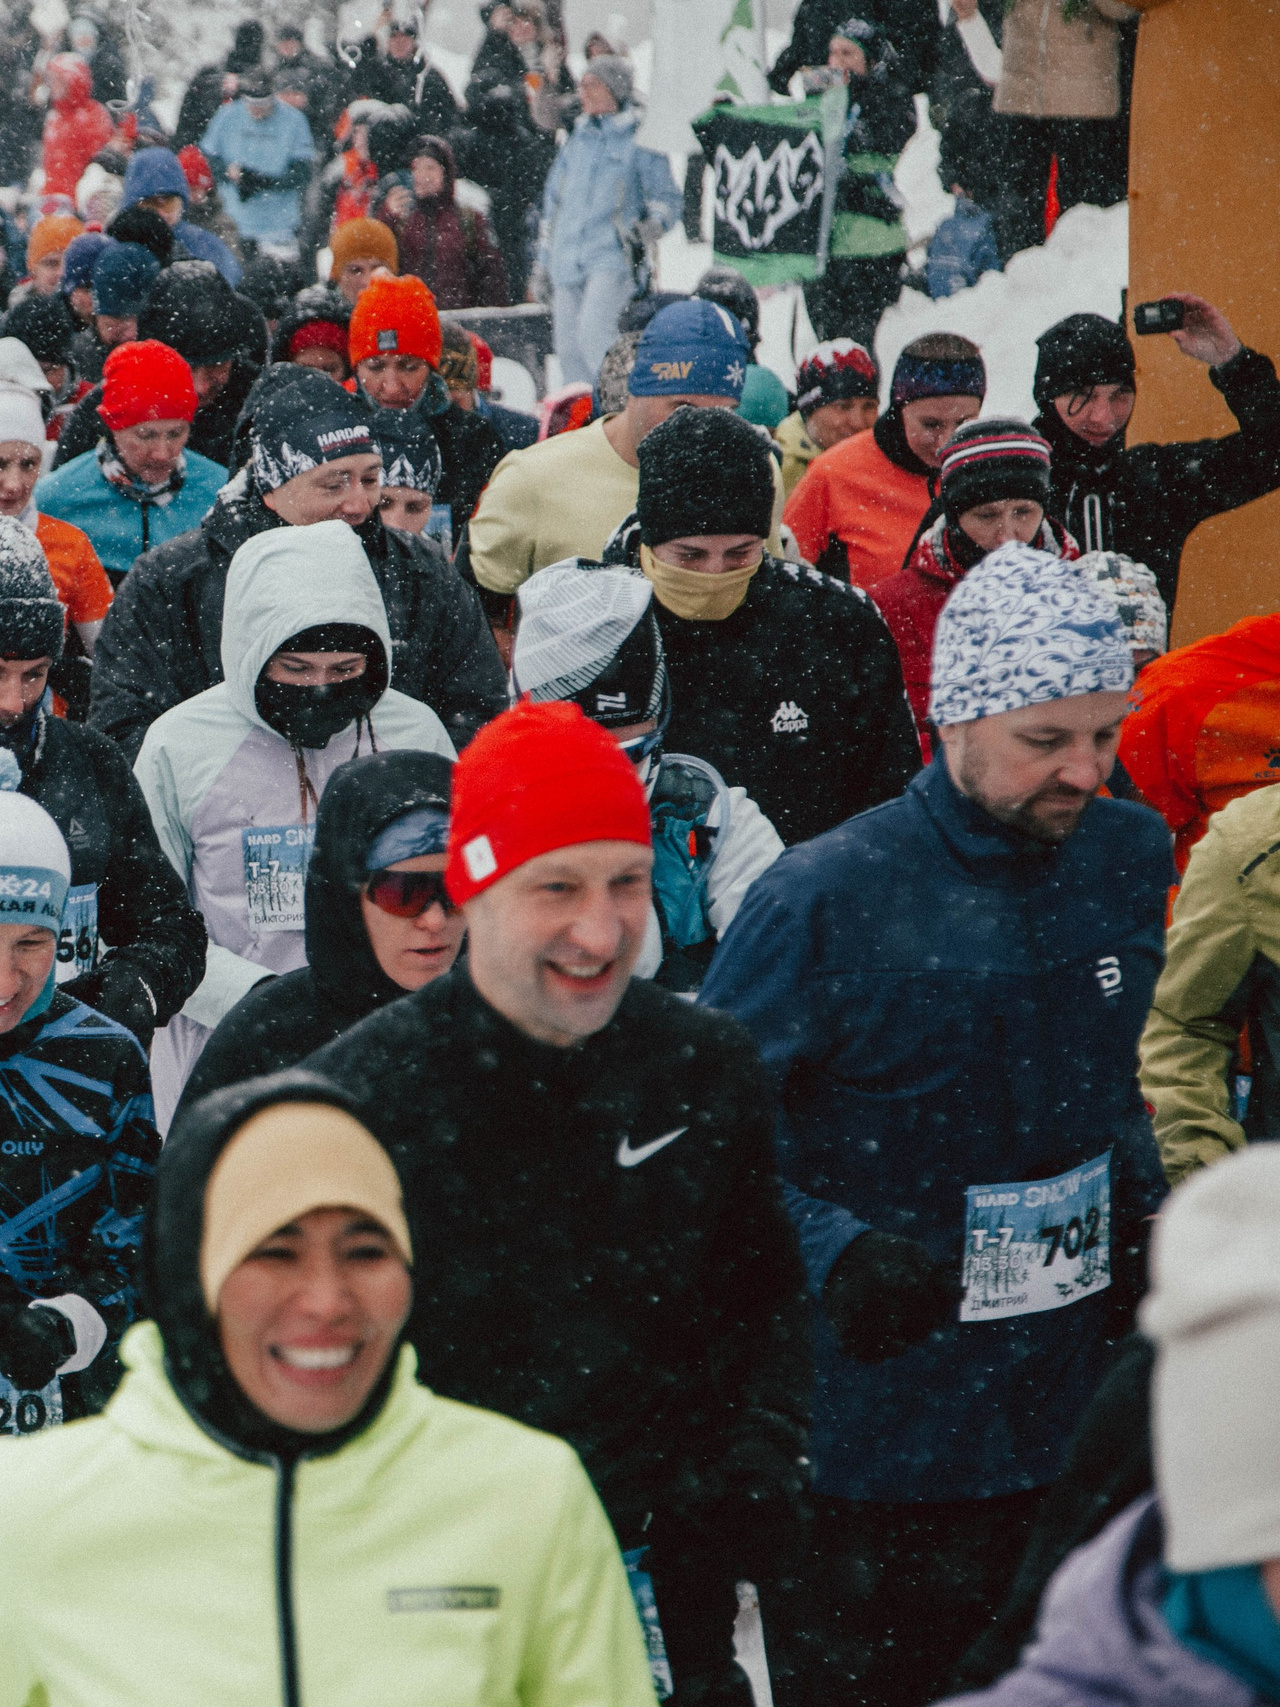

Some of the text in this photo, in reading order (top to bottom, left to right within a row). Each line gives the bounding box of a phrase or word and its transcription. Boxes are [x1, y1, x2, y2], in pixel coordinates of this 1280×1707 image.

[650, 361, 693, 381] RAY
[316, 427, 354, 447] HARD
[592, 709, 641, 720] ORDSKI
[247, 834, 282, 845] HARD
[252, 882, 289, 894] 13:30
[255, 913, 305, 924] ВИКТОРИЯ
[974, 1192, 1020, 1208] HARD
[1023, 1171, 1082, 1208] SNOW
[1040, 1206, 1100, 1268] 702
[971, 1255, 1021, 1271] 13:30
[971, 1292, 1028, 1311] ДМИТРИЙ
